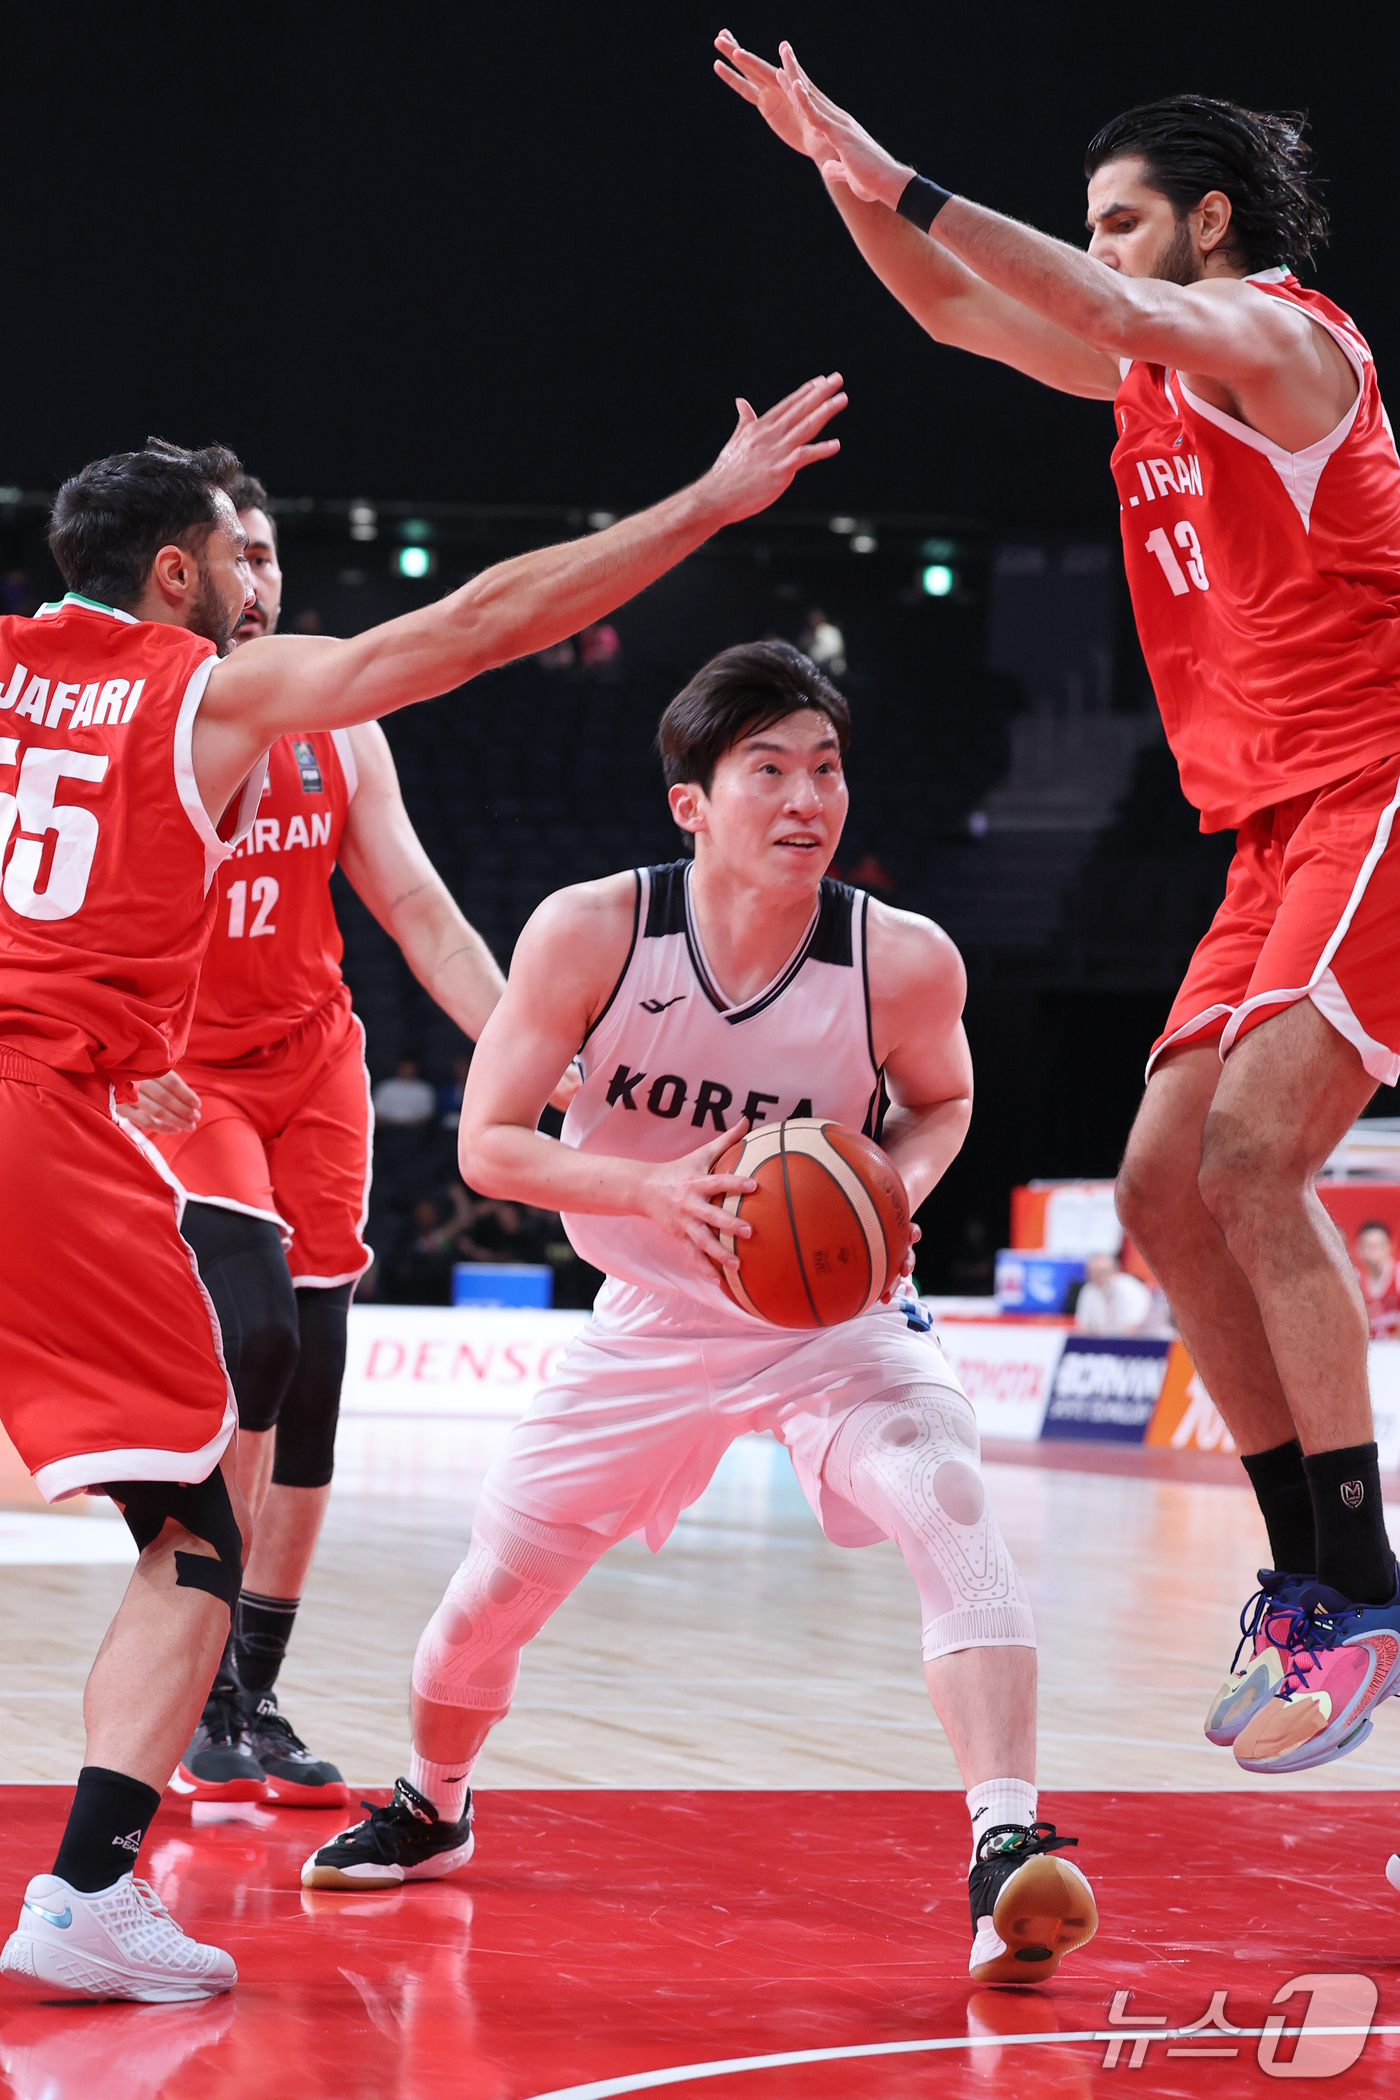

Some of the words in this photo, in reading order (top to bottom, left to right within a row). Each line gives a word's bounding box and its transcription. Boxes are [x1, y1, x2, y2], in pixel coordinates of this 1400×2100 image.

[1119, 454, 1204, 512] .IRAN
[1144, 520, 1210, 597] 13
[0, 662, 146, 730] JAFARI
[0, 736, 109, 921] 5
[225, 812, 331, 861] .IRAN
[226, 876, 280, 938] 12
